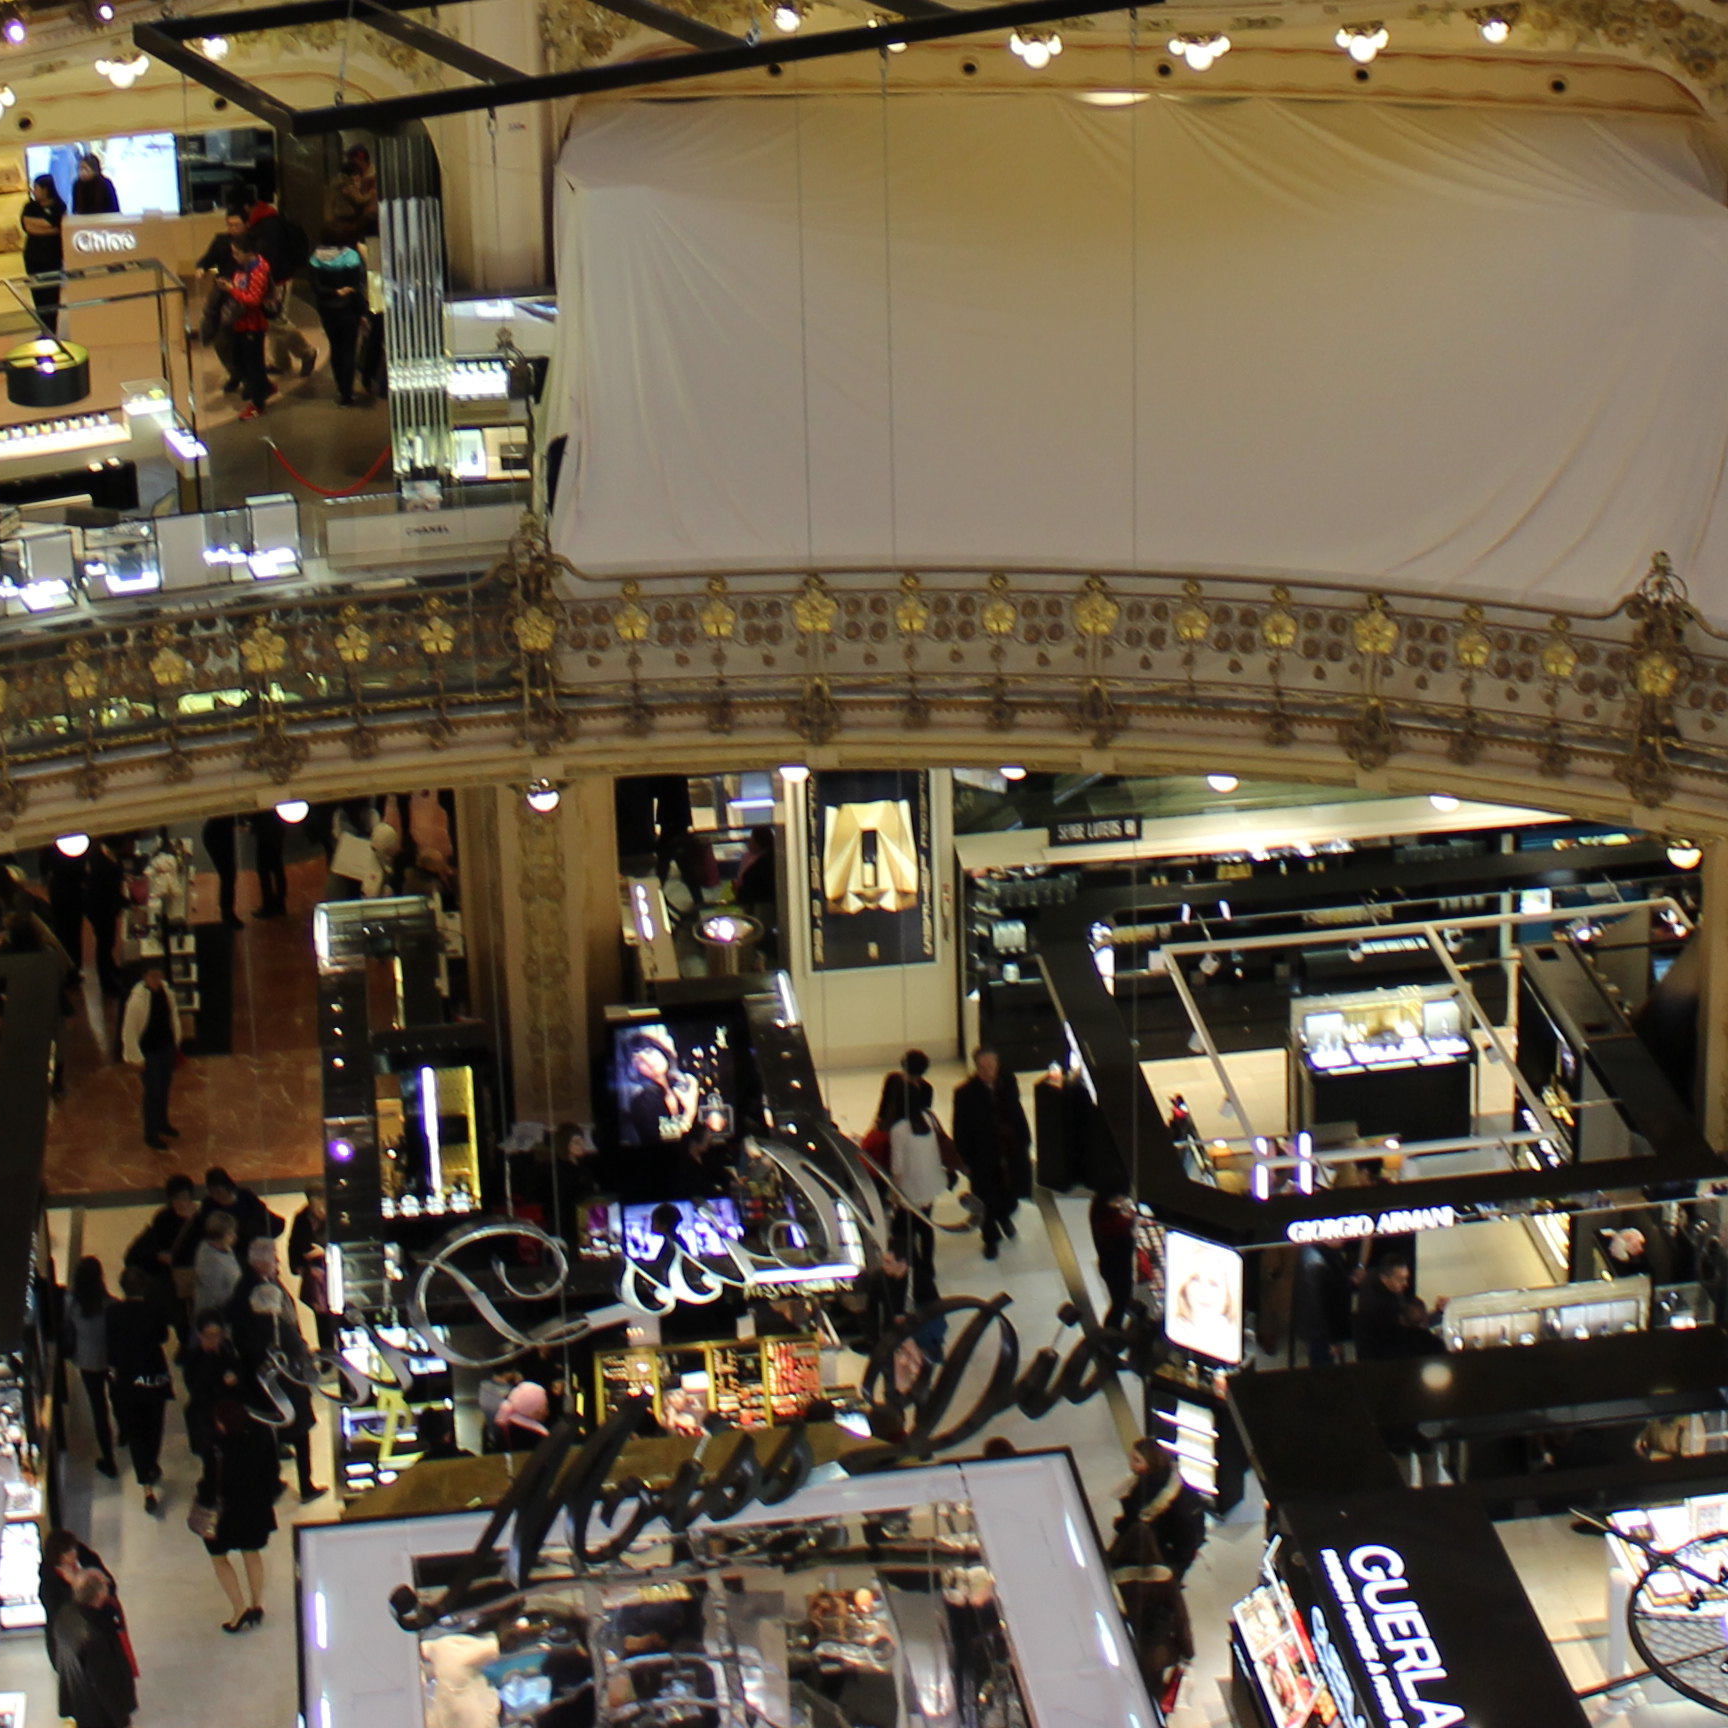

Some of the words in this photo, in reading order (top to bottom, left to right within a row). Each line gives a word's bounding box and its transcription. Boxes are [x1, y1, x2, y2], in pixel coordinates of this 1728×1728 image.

[73, 229, 136, 252] Chloé
[404, 523, 450, 536] CHANEL
[1287, 1214, 1375, 1243] GIORGIO
[1376, 1205, 1455, 1234] ARMANI
[389, 1391, 815, 1631] Miss
[1348, 1544, 1466, 1728] GUERLA
